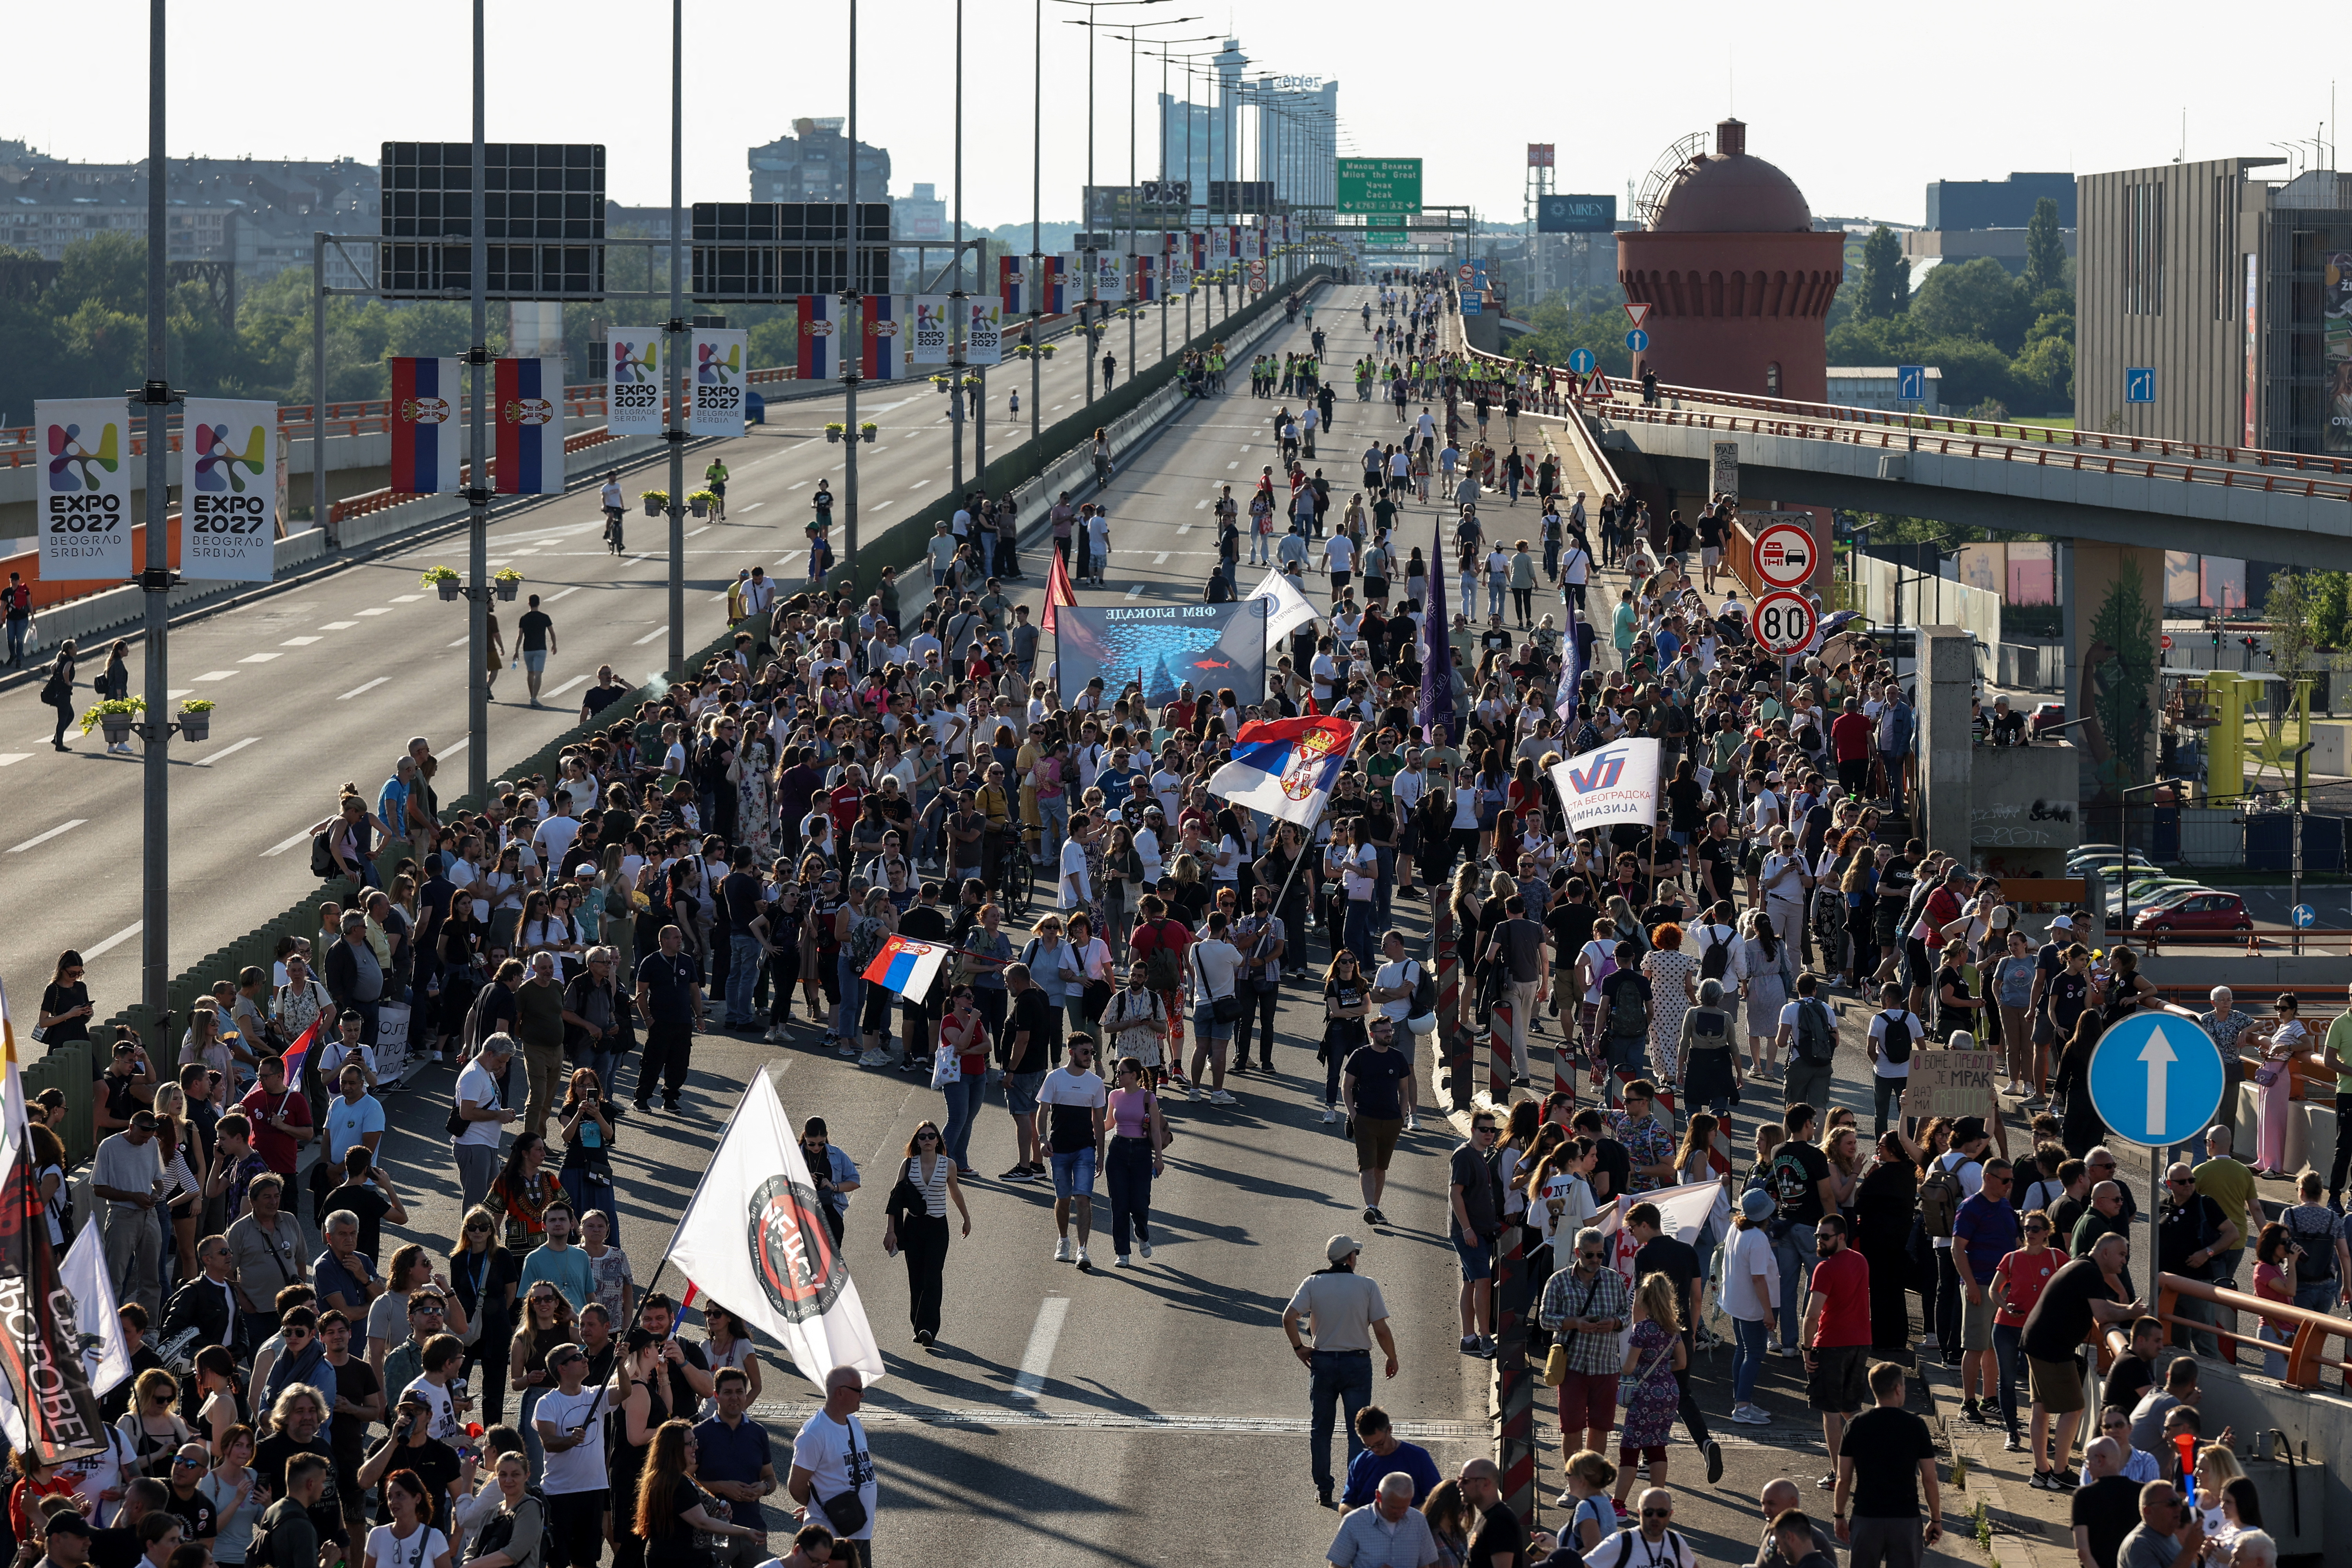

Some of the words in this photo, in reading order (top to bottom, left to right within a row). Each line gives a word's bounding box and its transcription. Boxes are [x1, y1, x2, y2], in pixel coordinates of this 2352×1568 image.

[1366, 190, 1392, 198] Čačak
[615, 385, 657, 395] EXPO
[698, 386, 739, 397] EXPO
[615, 396, 656, 407] 2027
[698, 398, 739, 409] 2027
[50, 494, 120, 513] EXPO
[194, 495, 264, 514] EXPO
[51, 514, 120, 533] 2027
[194, 515, 263, 534] 2027
[51, 535, 121, 545] BEOGRAD
[193, 536, 263, 546] BEOGRAD
[51, 547, 103, 557] SRBIJA
[193, 548, 245, 557] SRBIJA
[1764, 607, 1803, 640] 80
[1564, 801, 1583, 815] ЕСТА
[1585, 790, 1650, 804] БЕОГРАДСКА
[1914, 1055, 1920, 1070] О
[1955, 1053, 1993, 1070] ПРЕДУГО
[1935, 1070, 1946, 1084] ЈЕ
[1951, 1070, 1991, 1088] МРАК
[1913, 1085, 1932, 1098] ДАЈ
[1915, 1100, 1930, 1110] МИ
[790, 1187, 822, 1209] ОДРШКА
[787, 1263, 811, 1290] ОСТА!
[819, 1273, 843, 1308] ПОДРШК
[167, 1327, 194, 1353] SUOMY
